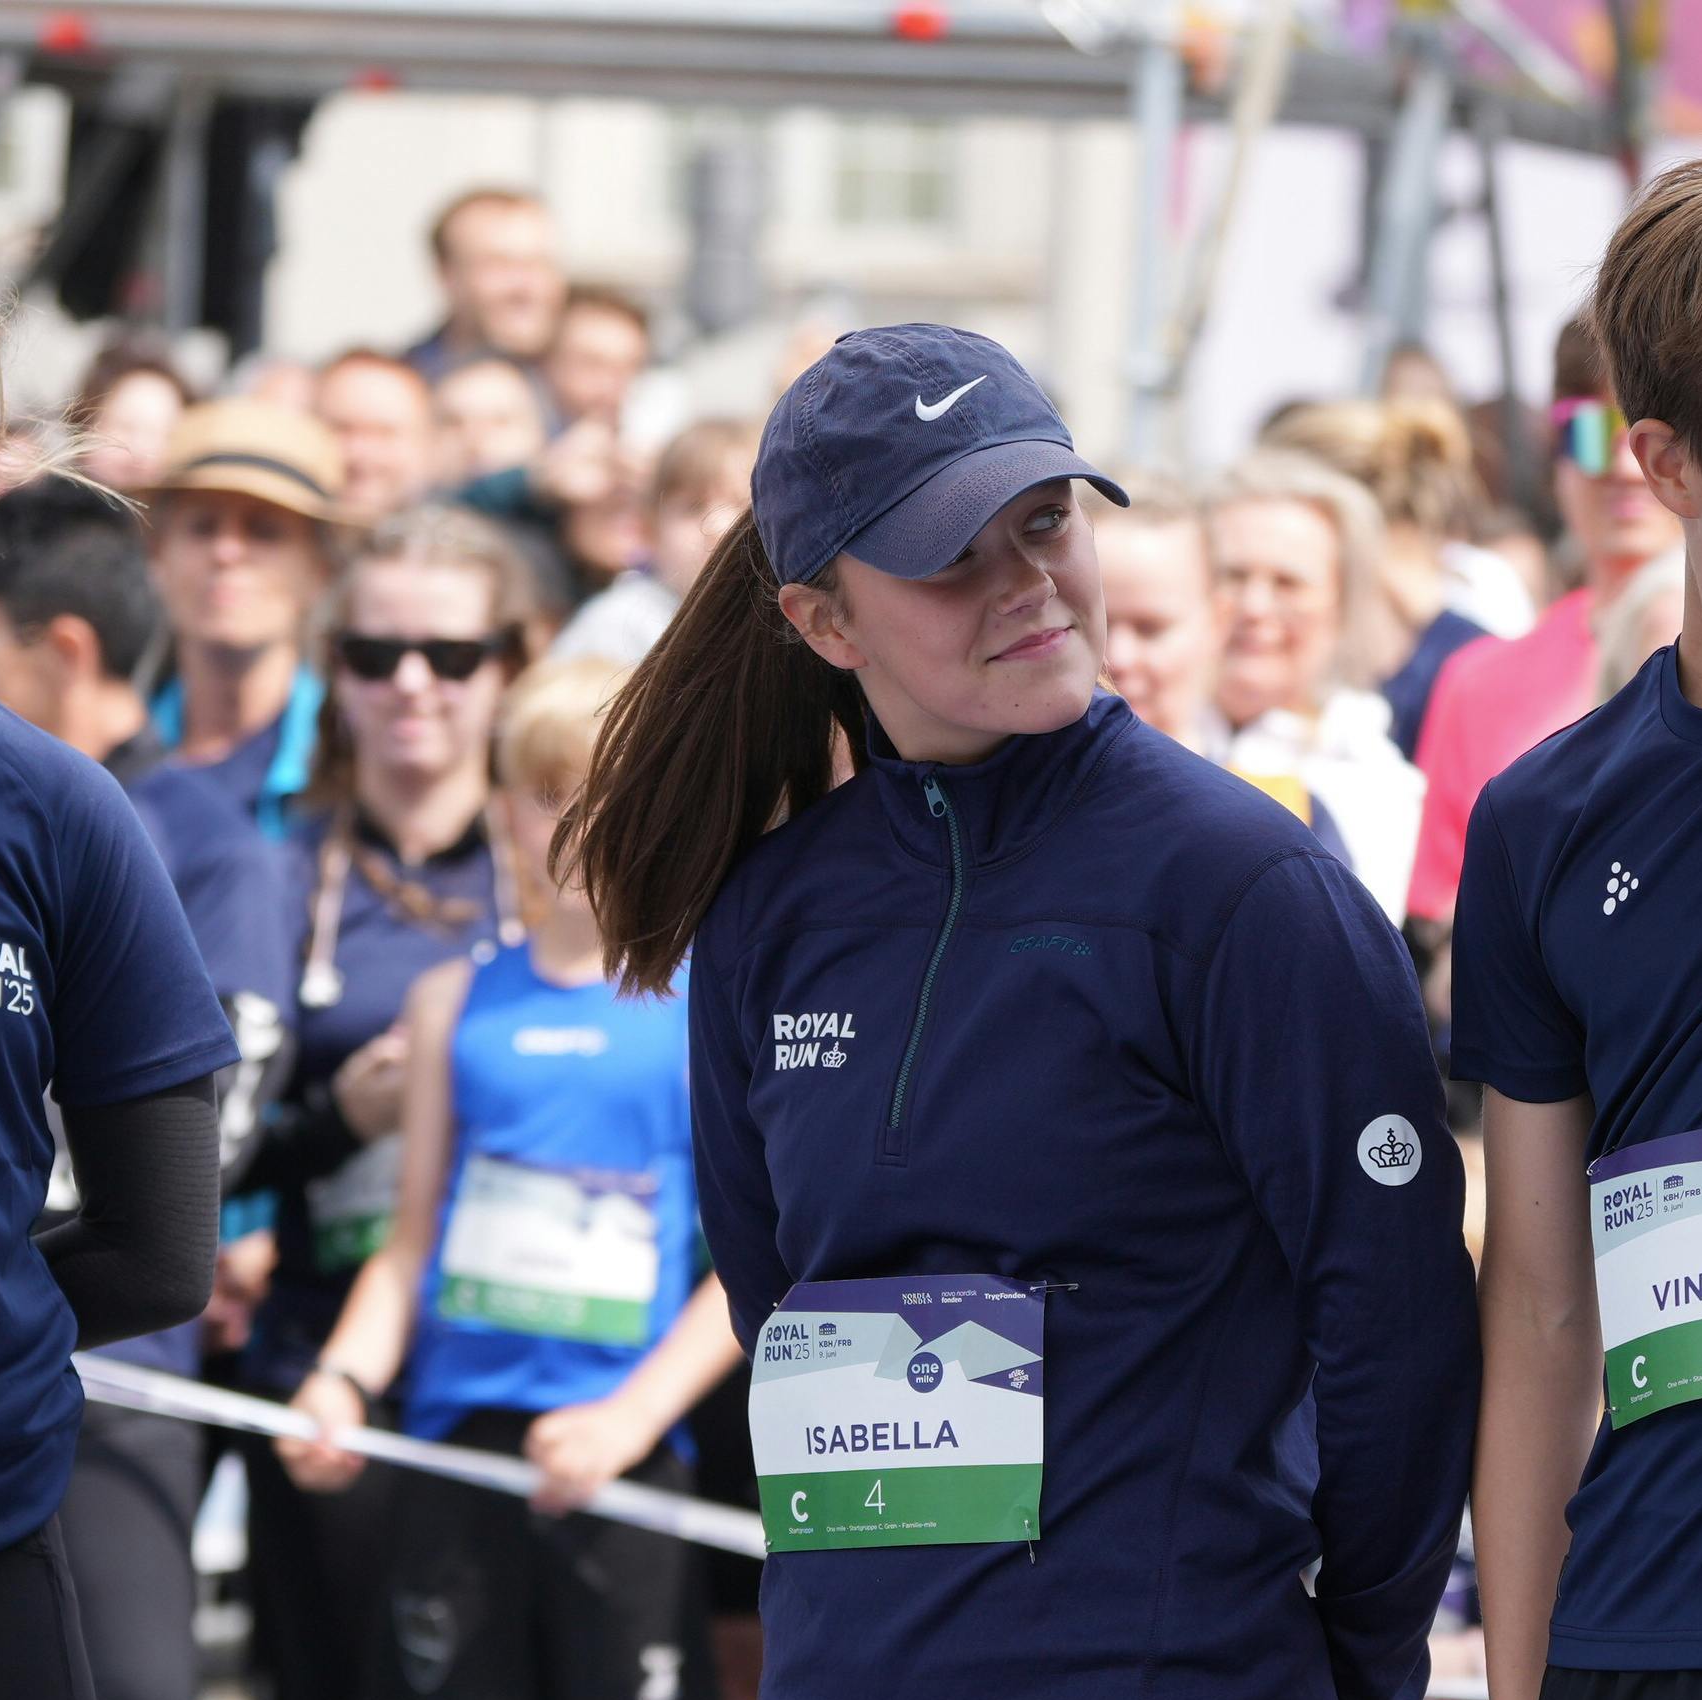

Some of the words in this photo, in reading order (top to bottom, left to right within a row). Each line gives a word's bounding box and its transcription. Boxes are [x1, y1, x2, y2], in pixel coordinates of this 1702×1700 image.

[773, 1012, 856, 1040] ROYAL
[774, 1042, 821, 1071] RUN
[1603, 1182, 1653, 1212] ROYAL
[1604, 1207, 1634, 1232] RUN
[984, 1292, 1026, 1301] TrygFonden
[766, 1324, 809, 1343] ROYAL
[764, 1344, 792, 1362] RUN
[911, 1363, 939, 1374] one
[915, 1375, 934, 1383] mile
[1631, 1355, 1648, 1389] C
[806, 1420, 959, 1455] ISABELLA
[791, 1491, 809, 1522] C
[864, 1479, 886, 1515] 4
